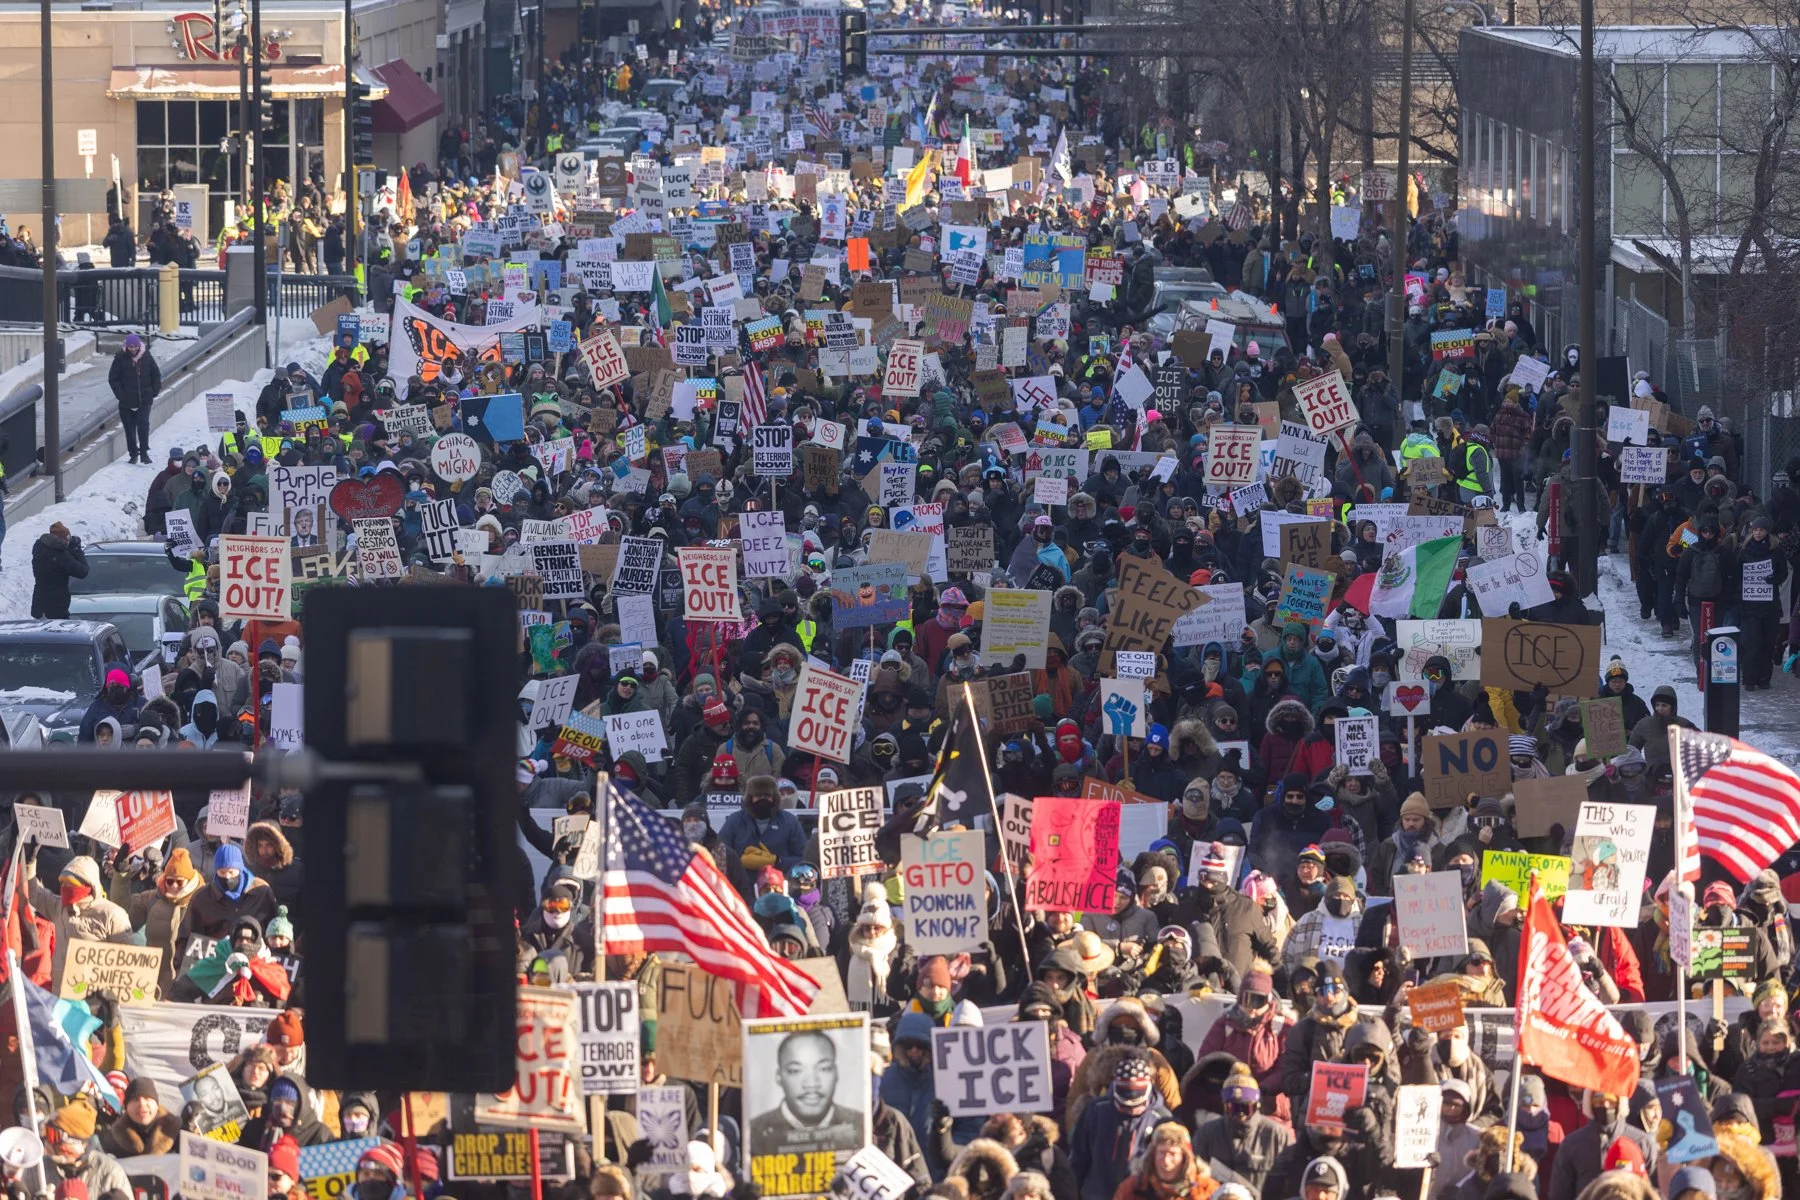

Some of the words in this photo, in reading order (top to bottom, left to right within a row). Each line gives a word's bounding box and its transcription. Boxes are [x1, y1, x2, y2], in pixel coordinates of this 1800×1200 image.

[734, 37, 767, 46] JUSTICE
[662, 173, 690, 183] FUCK
[1366, 176, 1387, 188] ICE
[668, 188, 686, 198] ICE
[1365, 188, 1388, 199] OUT!
[752, 205, 764, 217] ICE
[858, 211, 871, 224] ICE
[498, 216, 518, 229] STOP
[718, 223, 742, 234] YOU
[616, 263, 649, 275] JESUS
[1086, 267, 1124, 285] LOSERS
[620, 272, 649, 286] WEPT
[928, 295, 971, 311] PISSED
[488, 306, 514, 317] STRIKE
[703, 315, 730, 327] STRIKE
[412, 320, 463, 361] ICE
[677, 327, 706, 344] STOP
[754, 337, 775, 350] MSP
[1432, 340, 1449, 350] ICE
[1451, 339, 1473, 349] OUT
[586, 340, 617, 364] ICE
[1442, 348, 1465, 358] MSP
[890, 353, 917, 370] ICE
[595, 358, 624, 383] OUT!
[1157, 370, 1180, 384] ICE
[887, 371, 917, 389] OUT!
[1155, 386, 1180, 398] OUT
[1303, 383, 1341, 412] ICE
[395, 407, 415, 418] KEEP
[1155, 399, 1180, 413] MSP
[1311, 402, 1351, 430] OUT!
[625, 426, 644, 444] END
[755, 427, 790, 448] STOP
[1043, 438, 1059, 446] MSP
[1281, 424, 1300, 436] MN
[1302, 429, 1328, 446] NICE
[437, 436, 475, 451] CHINGA
[625, 441, 644, 460] ICE
[449, 449, 461, 459] LA
[755, 452, 763, 461] ICE
[764, 452, 791, 461] TERROR
[1213, 442, 1251, 460] ICE
[1624, 449, 1635, 459] The
[1637, 448, 1654, 458] Power
[1655, 451, 1663, 459] of
[438, 460, 477, 475] MIGRA
[755, 460, 791, 469] NOW!
[1210, 462, 1253, 478] OUT!
[1271, 455, 1300, 478] FUCK
[1300, 463, 1318, 485] ICE
[274, 467, 335, 497] Purple
[885, 490, 908, 499] FUCK
[912, 503, 942, 516] MOMS
[421, 502, 456, 532] FUCK
[170, 531, 190, 539] RENEE
[363, 527, 390, 536] FOUGHT
[524, 522, 564, 536] CIVILIANS
[955, 528, 989, 539] FIGHT
[357, 537, 396, 548] GESTAPO
[426, 528, 463, 560] ICE
[622, 537, 662, 546] ARREST
[948, 539, 991, 549] IGNORANCE
[226, 544, 265, 555] NEIGHBORS
[268, 546, 284, 554] SAY
[361, 552, 375, 562] SO
[376, 551, 398, 561] WILL
[533, 543, 577, 557] GENERAL
[623, 546, 660, 557] JONATHAN
[960, 548, 983, 556] NOT
[535, 556, 579, 571] STRIKE:
[622, 556, 637, 568] ROSS
[636, 557, 656, 568] FOR
[682, 553, 714, 562] NEIGHBORS
[716, 554, 731, 562] SAY
[947, 557, 995, 569] IMMIGRANTS
[226, 554, 280, 585] ICE
[746, 560, 787, 575] NUTZ
[1756, 562, 1771, 570] OUT
[551, 571, 569, 582] PATH
[570, 570, 581, 581] TO
[618, 567, 655, 583] MURDER
[685, 562, 730, 589] ICE
[1290, 573, 1327, 587] FAMILIES
[612, 580, 654, 592] NOW!
[1117, 563, 1198, 611] FEELS
[225, 586, 284, 614] OUT!
[687, 588, 734, 615] OUT!
[1286, 595, 1323, 612] TOGETHER
[1113, 601, 1171, 643] LIKE
[1117, 652, 1133, 661] ICE
[1134, 653, 1154, 661] OUT
[1510, 632, 1571, 671] ICE
[1117, 666, 1133, 674] ICE
[1134, 666, 1154, 676] OUT
[541, 681, 569, 701] ICE
[807, 675, 841, 695] NEIGHBORS
[840, 684, 856, 695] SAY
[989, 688, 1033, 706] LIVES
[801, 688, 849, 725] ICE
[535, 703, 569, 725] OUT
[611, 716, 631, 732] No
[635, 716, 655, 727] one
[1347, 724, 1365, 732] MN
[616, 734, 625, 742] is
[629, 730, 655, 740] above
[796, 717, 847, 756] OUT!
[1345, 731, 1368, 741] NICE
[562, 743, 592, 758] MSP
[1438, 737, 1499, 776] NO
[1348, 755, 1367, 768] ICE
[706, 794, 724, 803] ICE
[725, 794, 744, 803] OUT
[827, 790, 873, 812] KILLER
[18, 807, 40, 819] ICE
[117, 791, 168, 826] LOVE
[1583, 806, 1615, 822] THIS
[1626, 810, 1637, 822] IS
[30, 820, 51, 829] OUT
[822, 810, 880, 833] ICE
[1609, 825, 1635, 837] who
[921, 839, 963, 862] ICE
[1489, 853, 1565, 869] MINNESOTA
[905, 862, 974, 889] GTFO
[1028, 880, 1082, 907] ABOLISH
[1085, 883, 1114, 910] ICE
[910, 894, 976, 914] DONCHA
[1609, 908, 1626, 919] of?
[914, 916, 980, 938] KNOW?
[91, 968, 134, 985] SNIFFS
[1422, 1014, 1455, 1029] FELON
[935, 1027, 1035, 1070] FUCK
[958, 1066, 1040, 1109] ICE
[1326, 1078, 1352, 1090] ICE
[640, 1091, 657, 1103] WE
[660, 1090, 681, 1102] ARE
